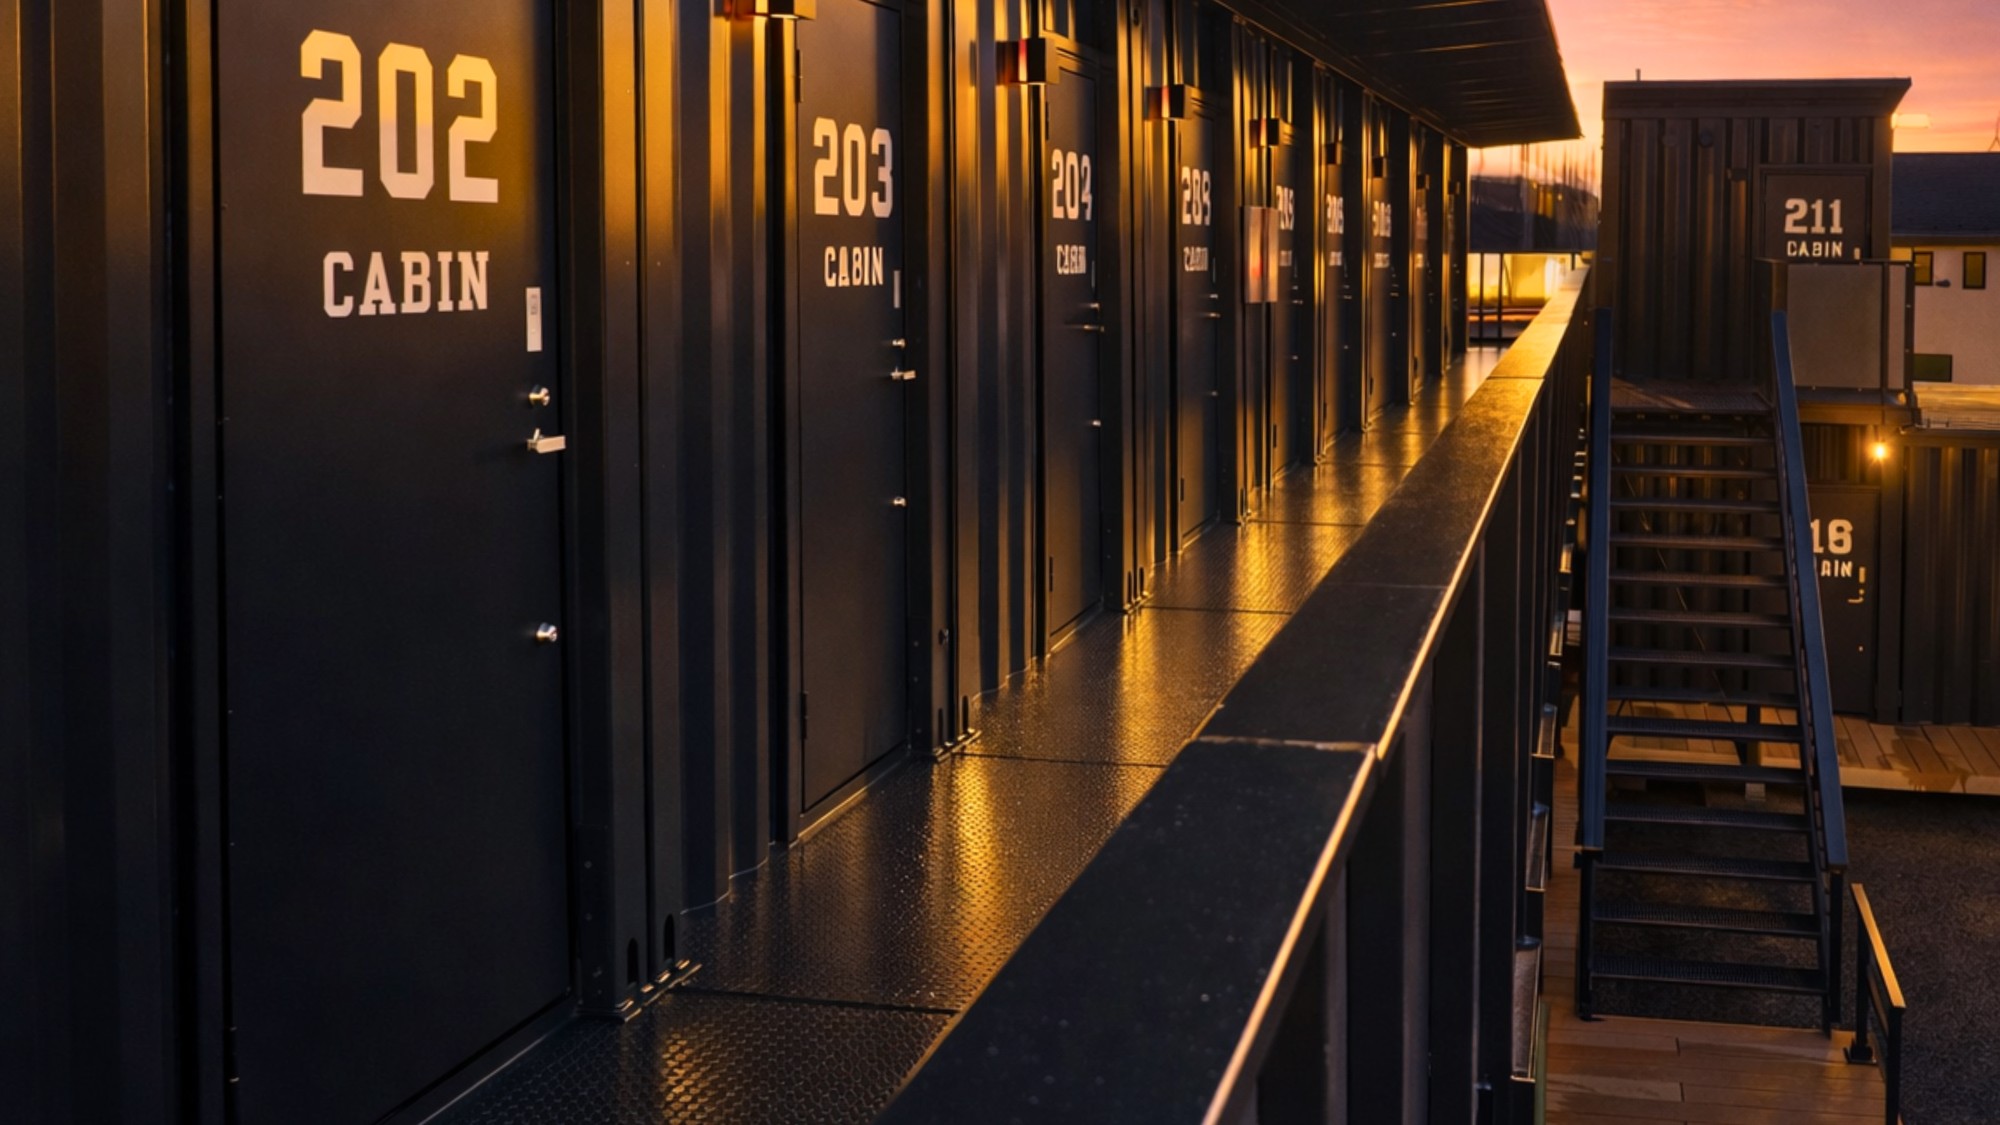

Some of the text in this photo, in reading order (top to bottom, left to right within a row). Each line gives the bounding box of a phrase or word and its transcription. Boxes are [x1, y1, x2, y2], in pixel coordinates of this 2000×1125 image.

[300, 29, 499, 203] 202
[813, 117, 893, 218] 203
[1784, 198, 1843, 234] 211
[824, 246, 884, 287] CABIN
[1786, 241, 1843, 257] CABIN
[323, 251, 489, 317] CABIN
